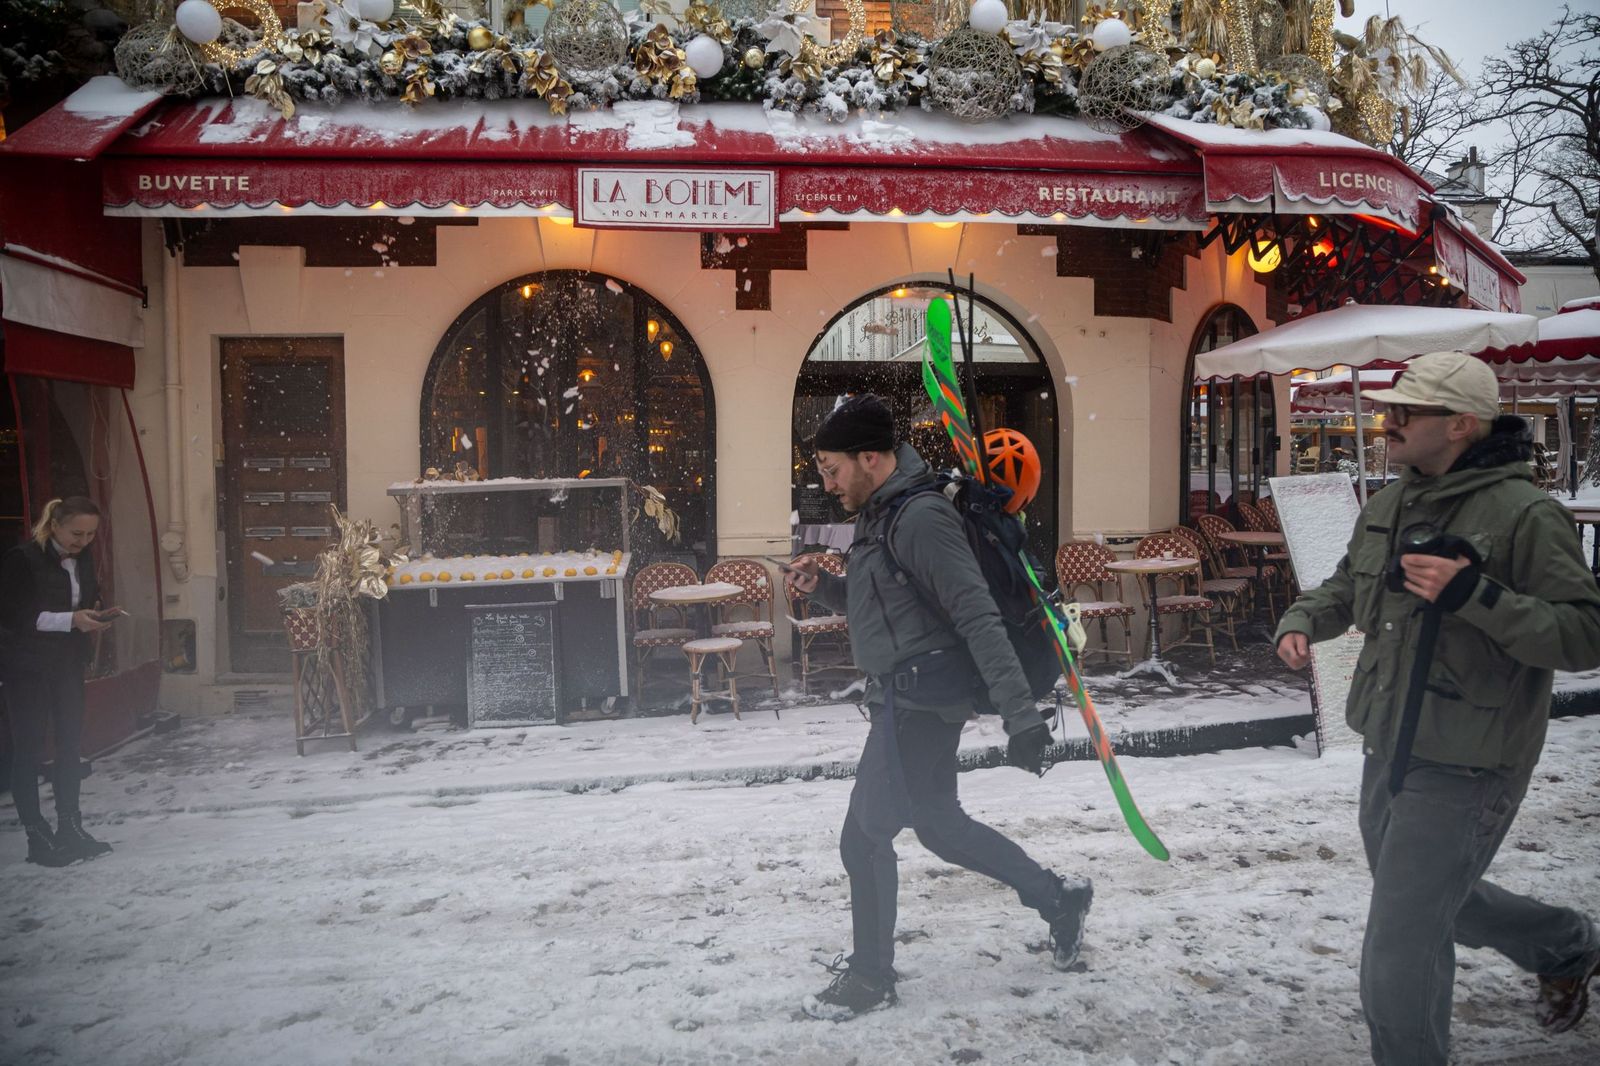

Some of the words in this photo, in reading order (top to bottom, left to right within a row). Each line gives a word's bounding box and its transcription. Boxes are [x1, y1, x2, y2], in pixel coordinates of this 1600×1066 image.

[139, 175, 249, 191] BUVETTE
[1319, 171, 1393, 196] LICENCE
[493, 189, 524, 197] PARIS
[529, 189, 557, 197] XVIII
[593, 178, 627, 203] LA
[646, 179, 762, 206] BOHEME
[795, 193, 842, 202] LICENCE
[847, 194, 858, 203] IV
[1038, 186, 1179, 205] RESTAURANT
[612, 210, 728, 220] MONTMARTRE
